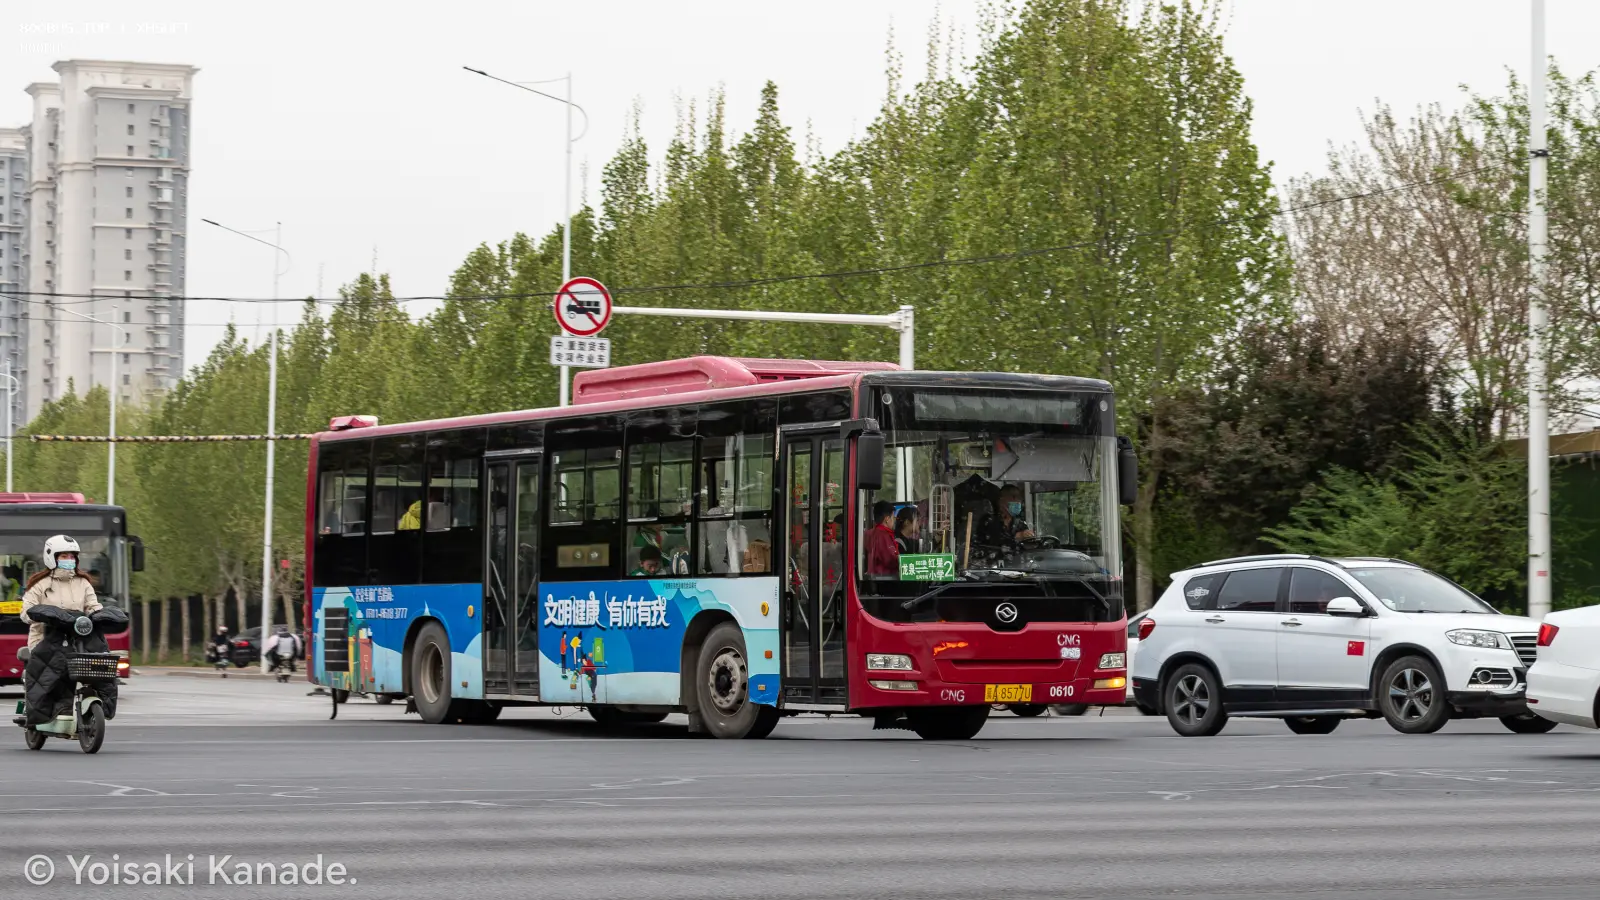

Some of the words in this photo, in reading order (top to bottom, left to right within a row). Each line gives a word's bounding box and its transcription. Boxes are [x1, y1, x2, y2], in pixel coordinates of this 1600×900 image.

[928, 569, 944, 581] 小学
[943, 560, 953, 577] 2
[543, 590, 606, 629] 文明健康
[605, 590, 670, 628] 有你有我
[1057, 633, 1080, 646] CNG
[940, 688, 965, 702] CNG
[1049, 685, 1074, 697] 0610
